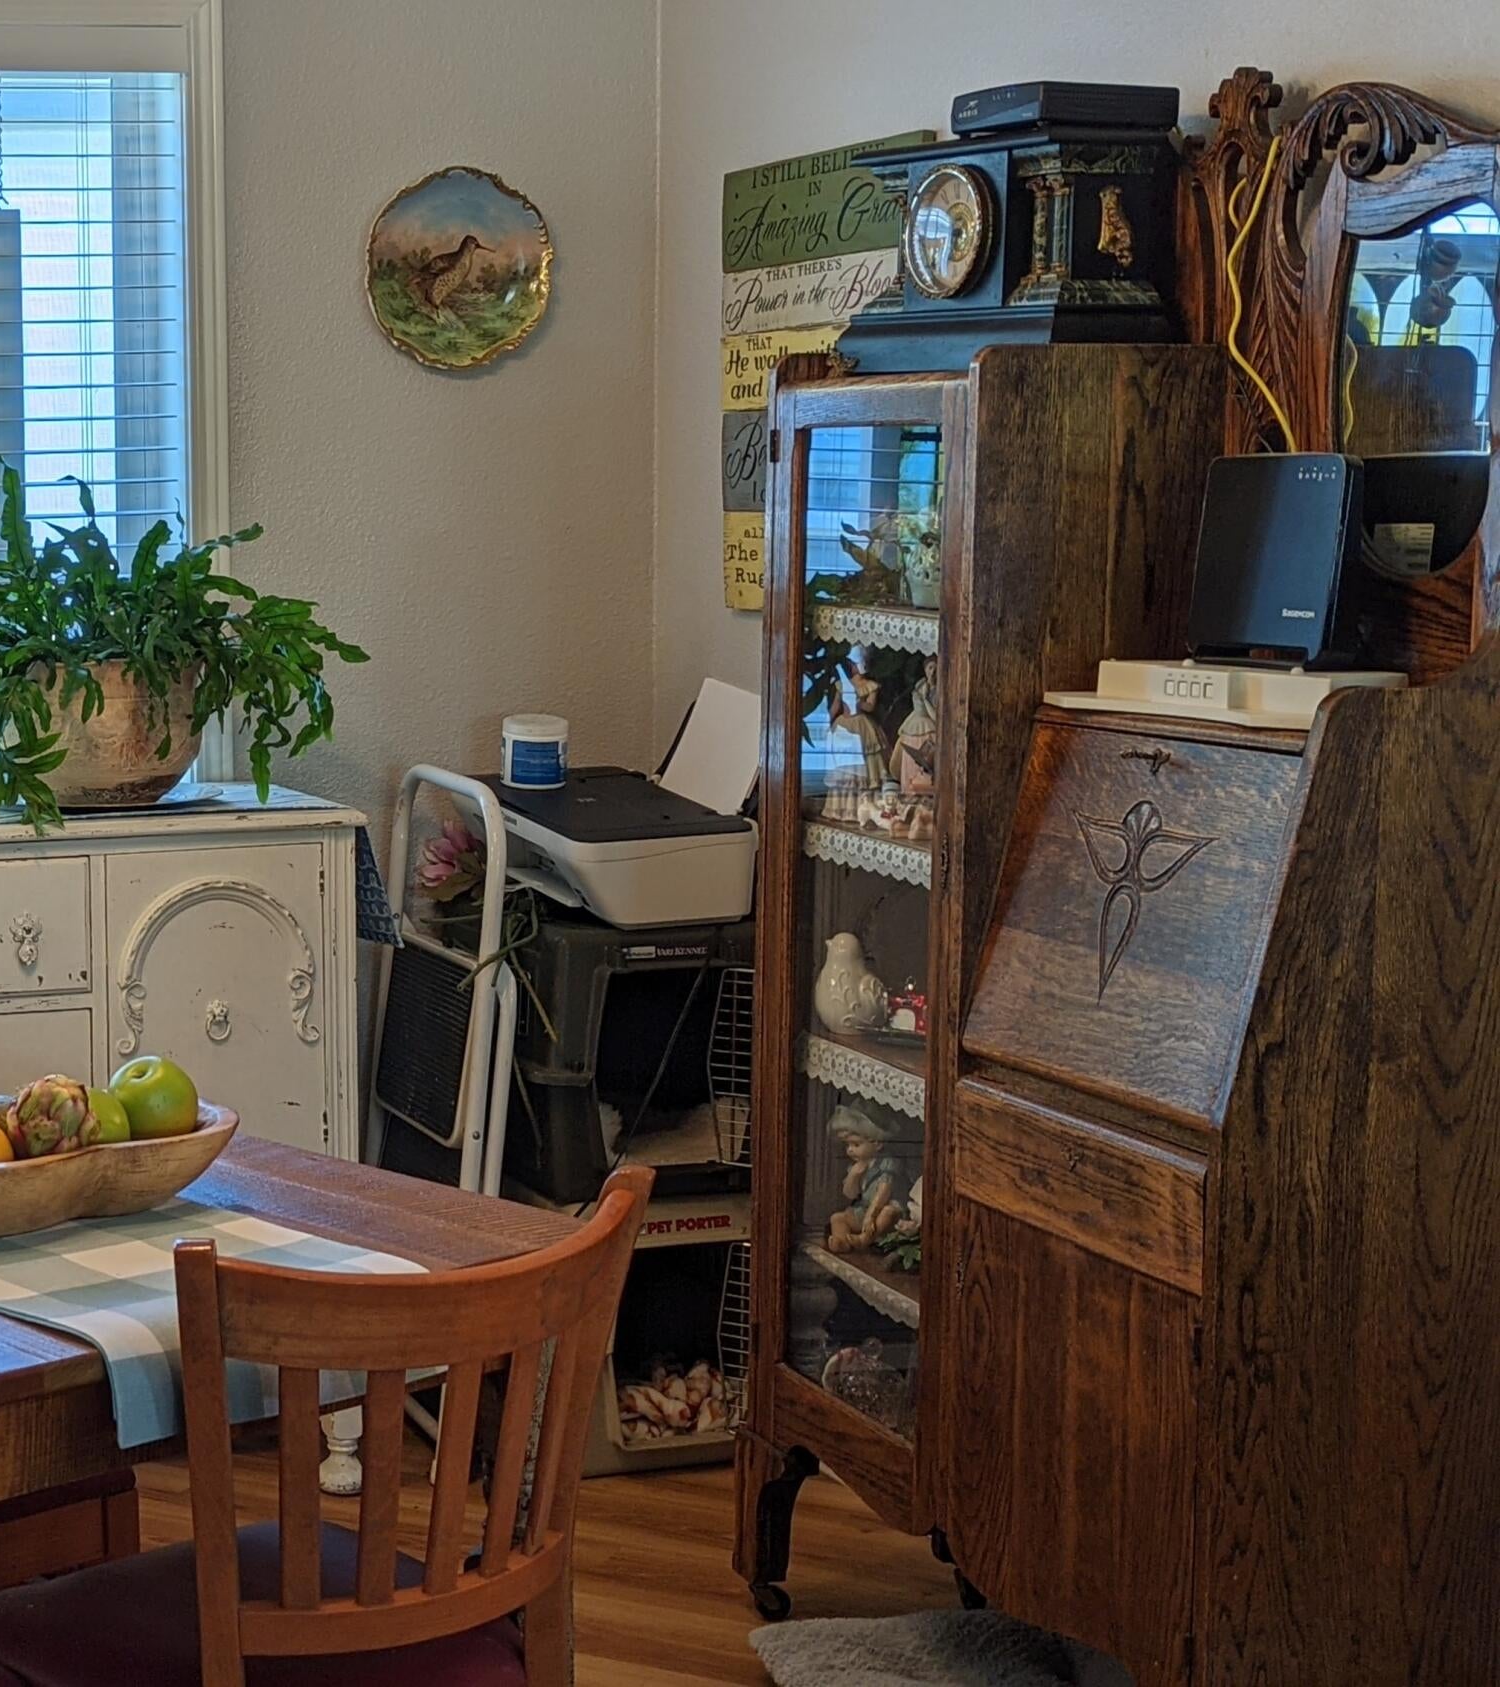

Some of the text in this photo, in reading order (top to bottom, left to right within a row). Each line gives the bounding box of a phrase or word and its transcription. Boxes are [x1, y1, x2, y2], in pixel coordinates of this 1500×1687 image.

[751, 142, 885, 189] I STILL BELI
[808, 180, 822, 197] IN
[725, 195, 830, 267] Amazing
[766, 258, 843, 283] THAT THERE'S
[725, 258, 894, 331] Power in the Bloo
[746, 336, 773, 352] THAT
[725, 349, 750, 379] He
[731, 376, 764, 400] and
[727, 544, 759, 562] The
[647, 1220, 673, 1235] PET
[675, 1215, 732, 1232] PORTER
